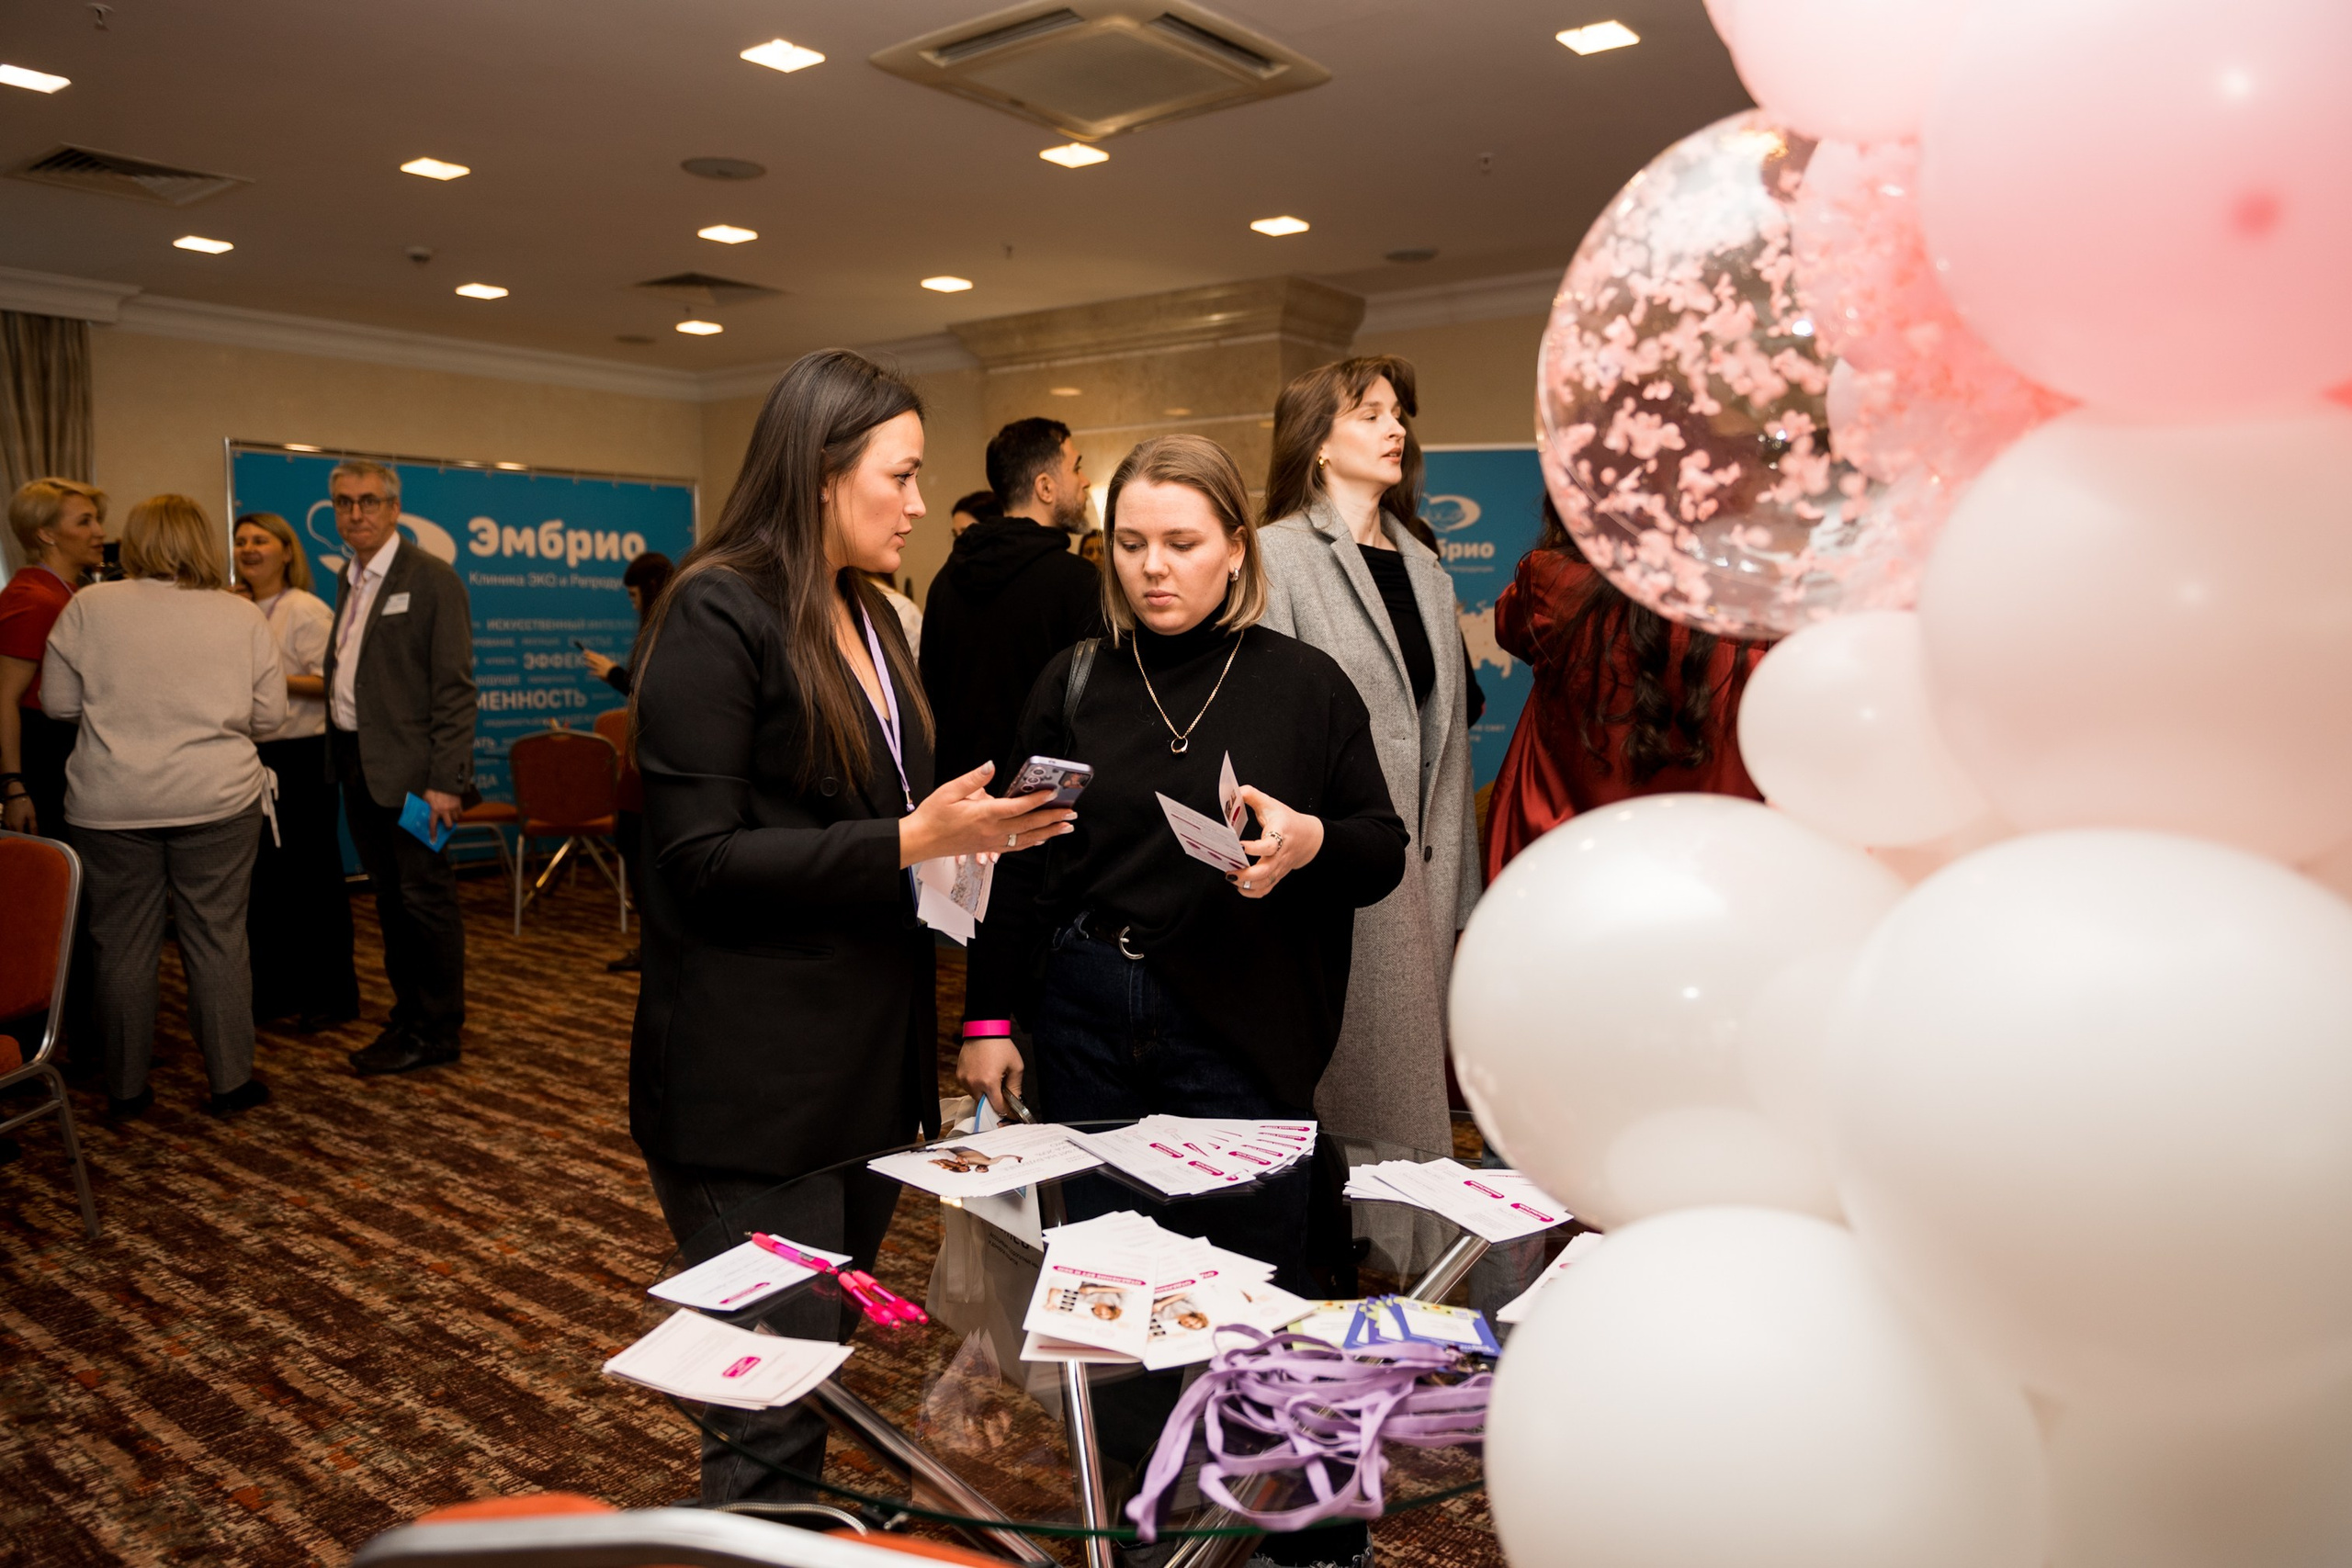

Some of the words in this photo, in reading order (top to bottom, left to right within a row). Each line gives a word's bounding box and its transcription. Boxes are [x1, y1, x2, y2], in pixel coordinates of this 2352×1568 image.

[468, 515, 647, 568] Эмбрио
[469, 571, 525, 587] Клиника
[527, 571, 556, 588] ЭКО
[559, 575, 567, 586] и
[486, 617, 586, 631] ИСКУССТВЕННЫЙ
